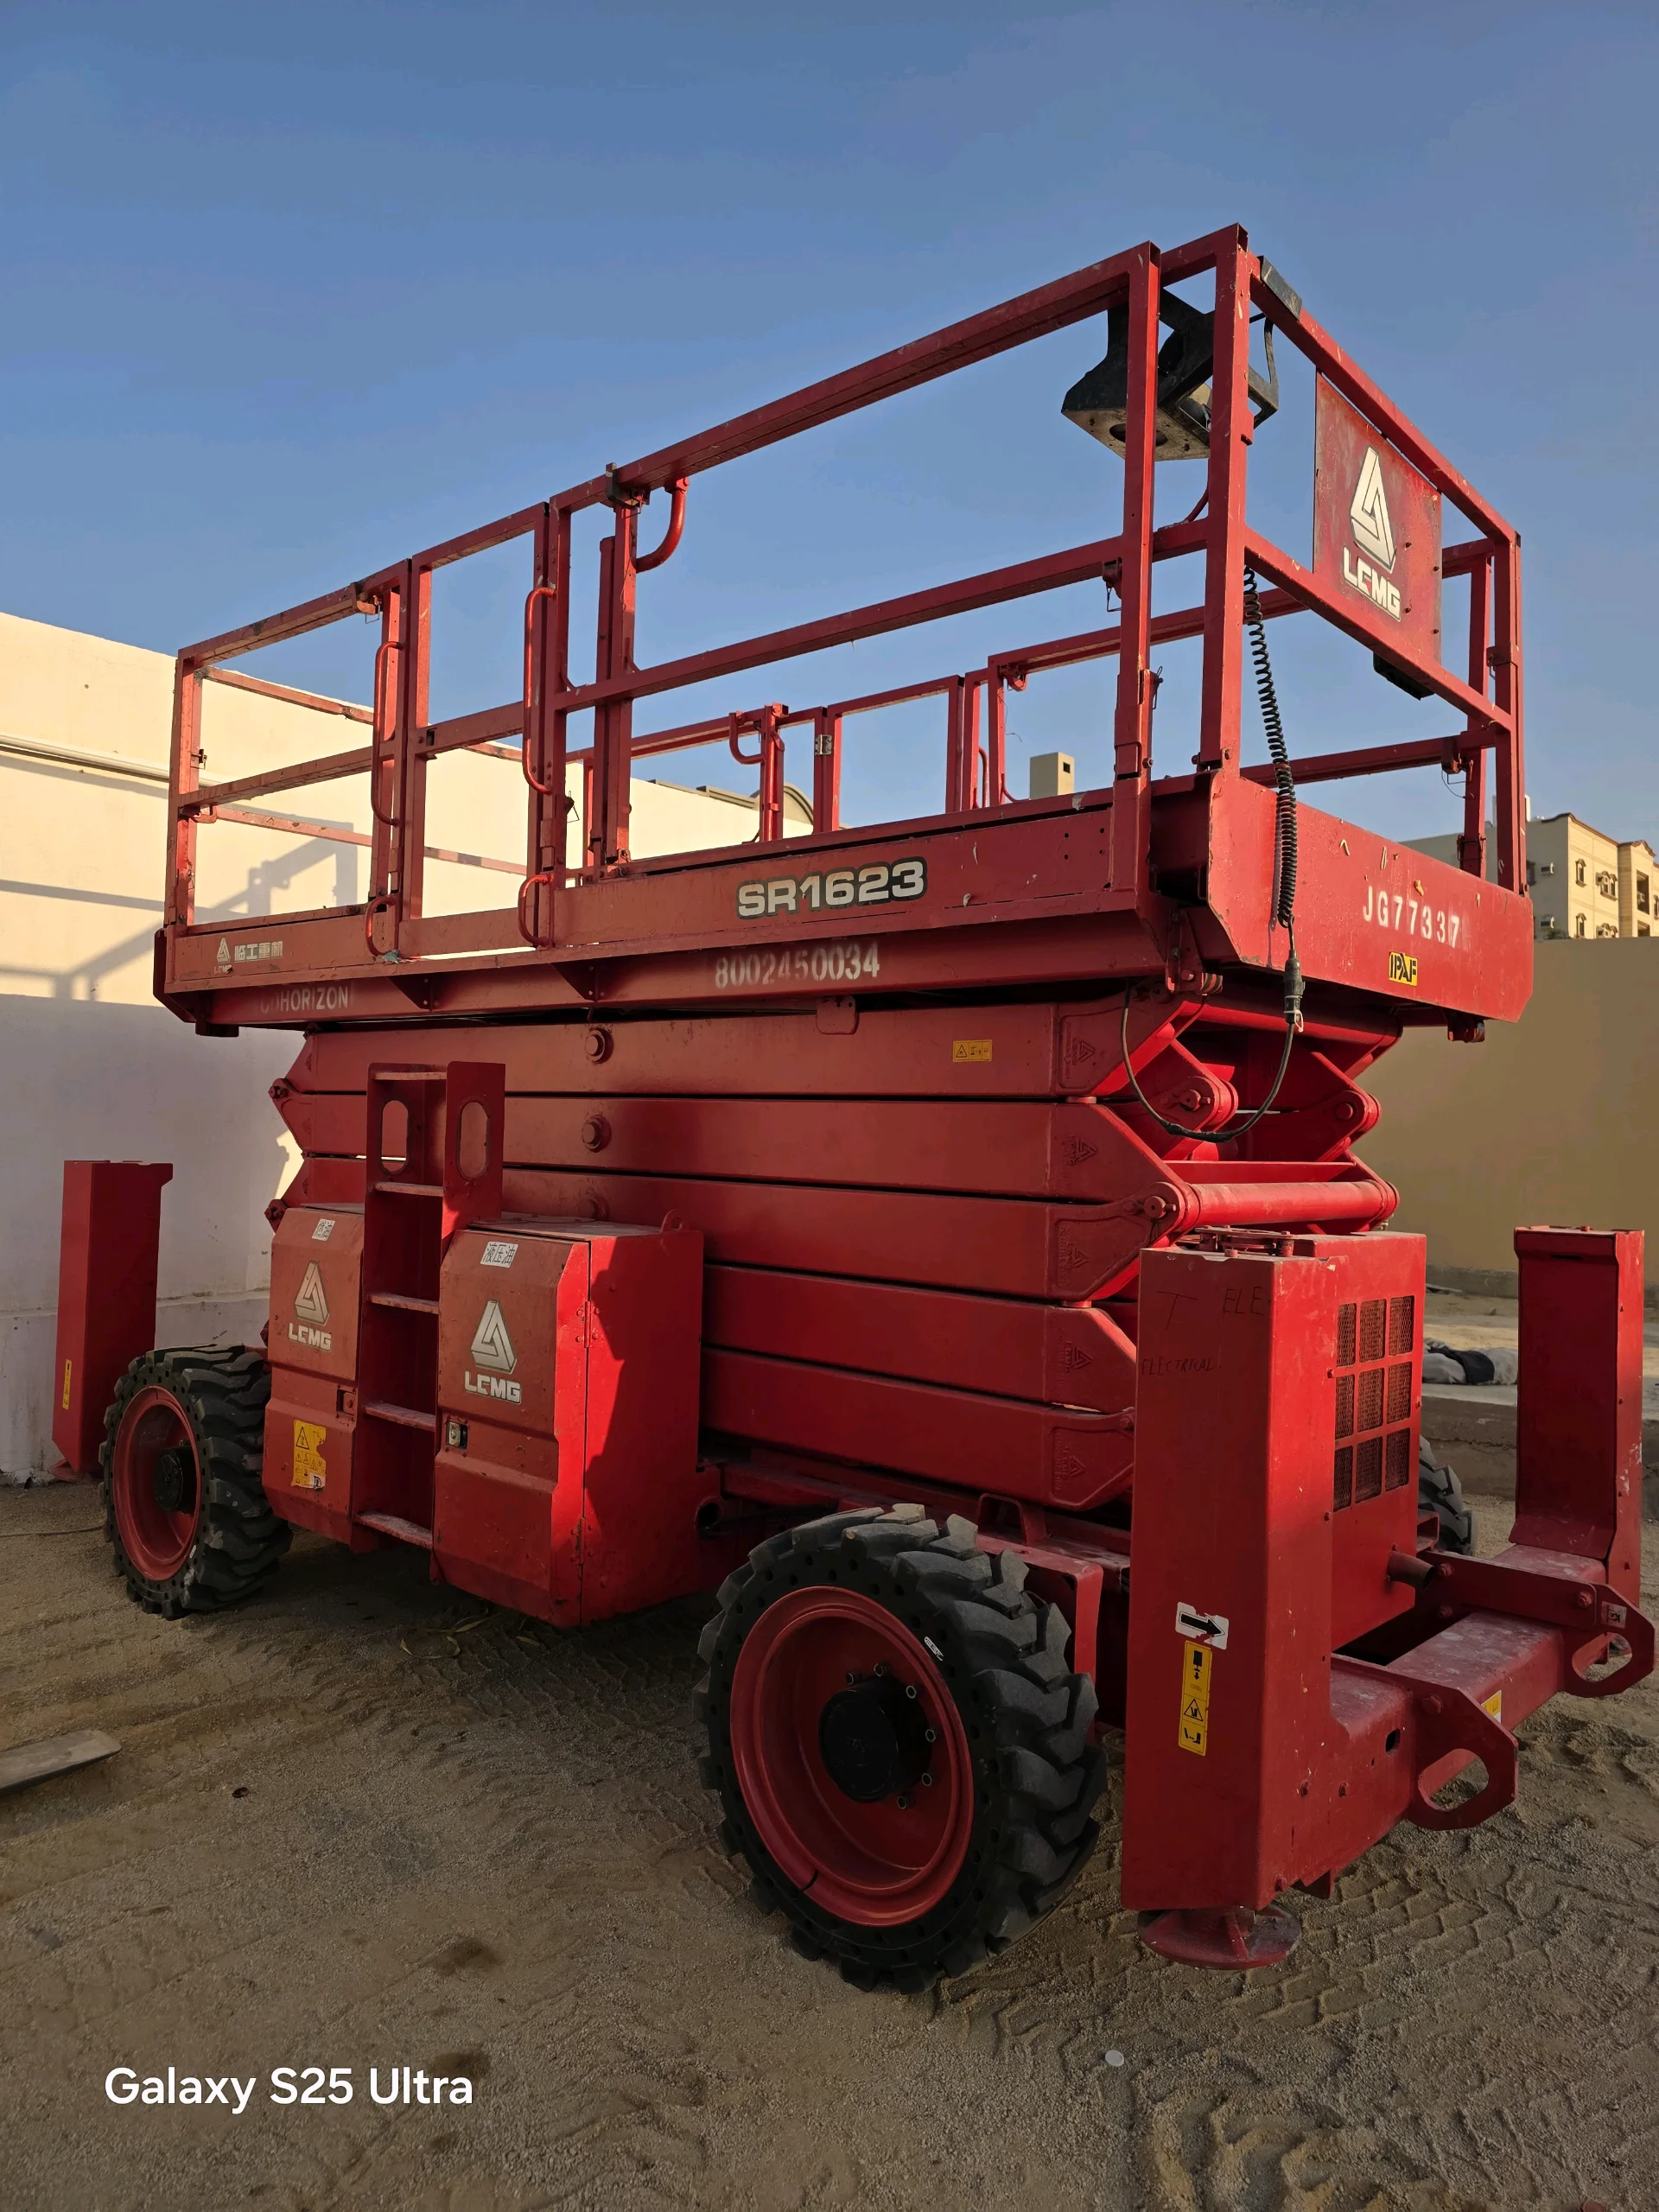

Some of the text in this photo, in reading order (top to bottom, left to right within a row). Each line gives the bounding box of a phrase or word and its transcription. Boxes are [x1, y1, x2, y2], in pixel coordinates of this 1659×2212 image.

[737, 861, 925, 918] SR1623
[1363, 886, 1460, 949] JG77337
[234, 940, 283, 963] 临工重机
[715, 940, 880, 989] 8002450034
[1389, 952, 1417, 983] IPAF
[482, 1243, 516, 1264] 液压油
